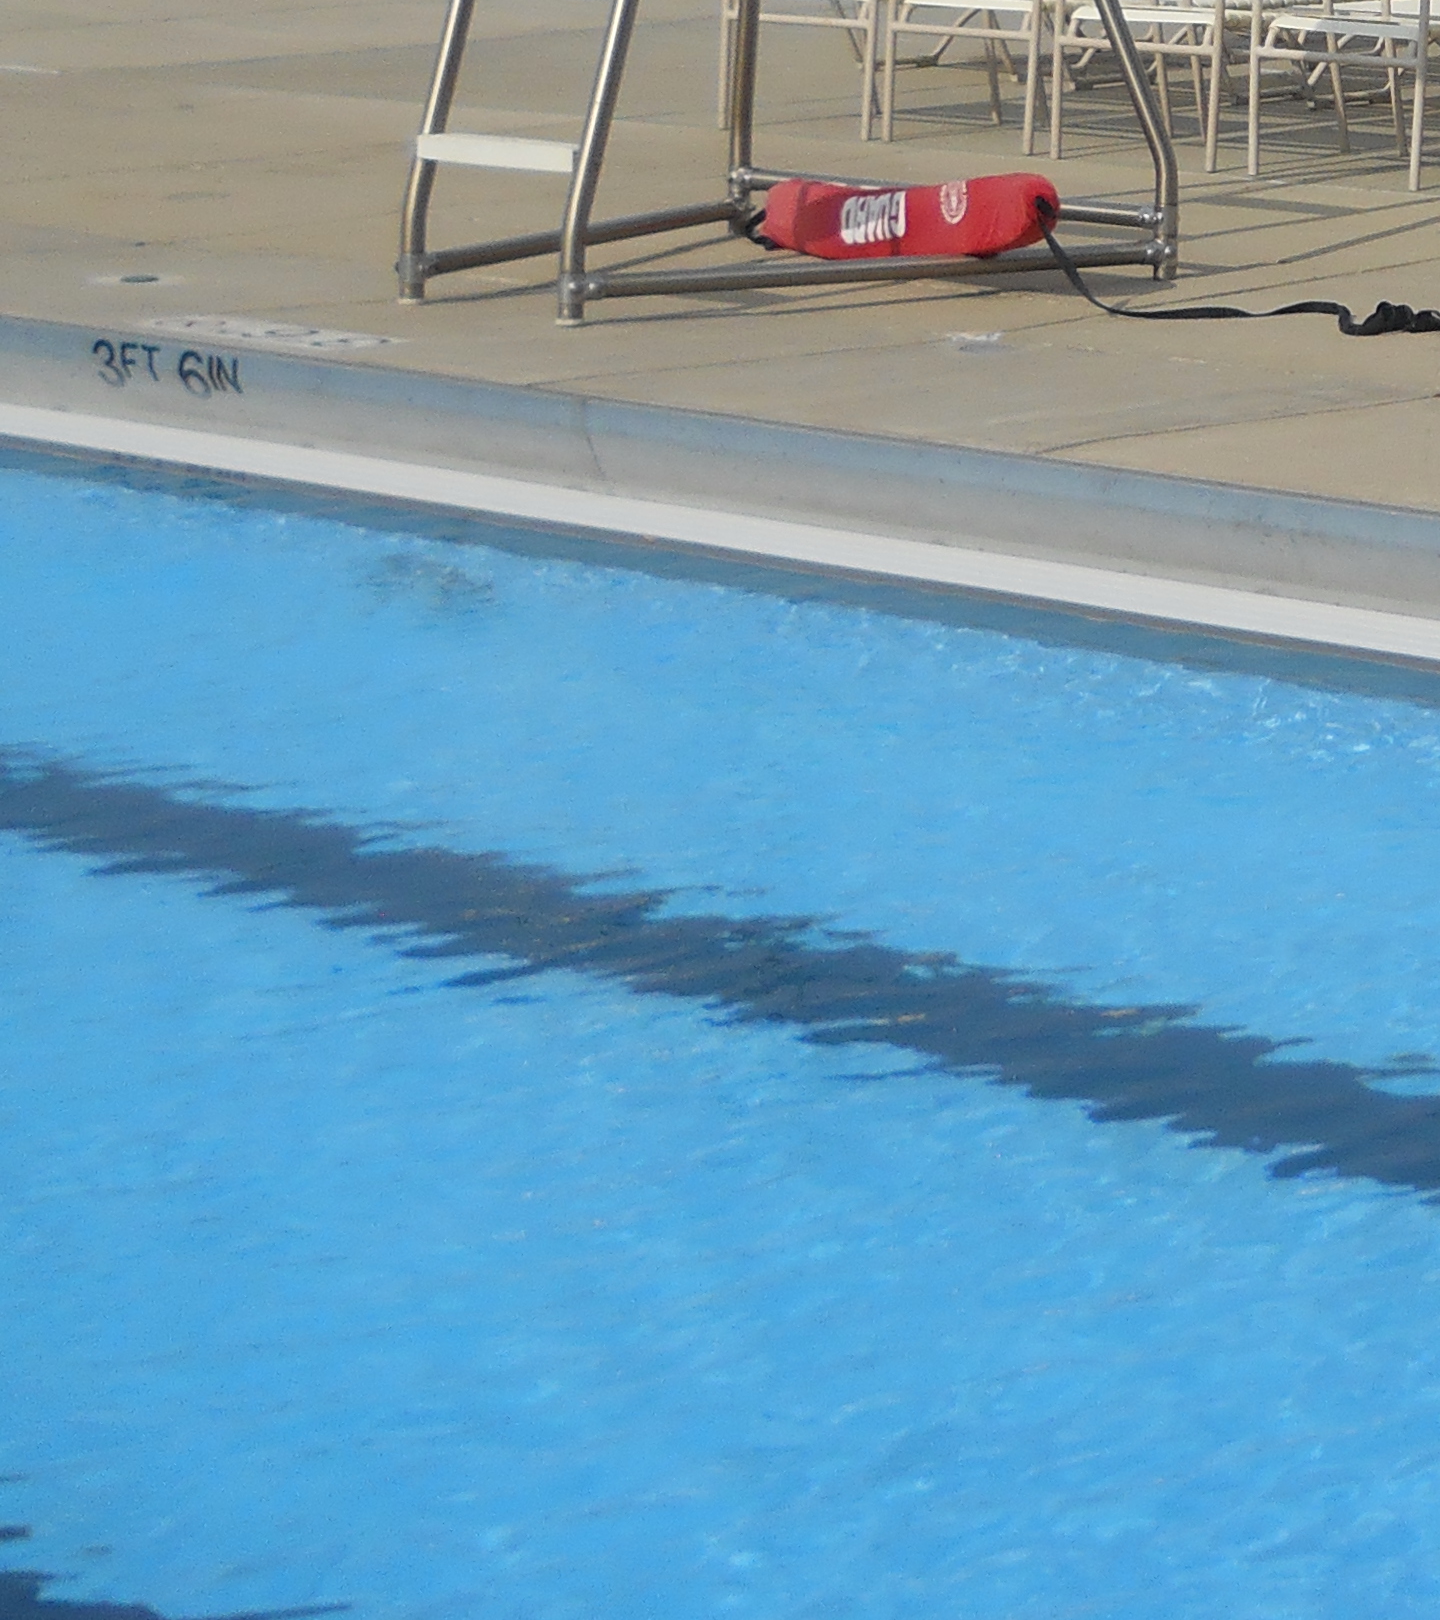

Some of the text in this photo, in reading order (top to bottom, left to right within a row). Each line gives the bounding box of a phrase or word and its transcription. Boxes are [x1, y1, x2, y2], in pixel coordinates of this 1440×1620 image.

[840, 190, 906, 244] GUARD
[92, 338, 244, 398] 3FT 6IN
